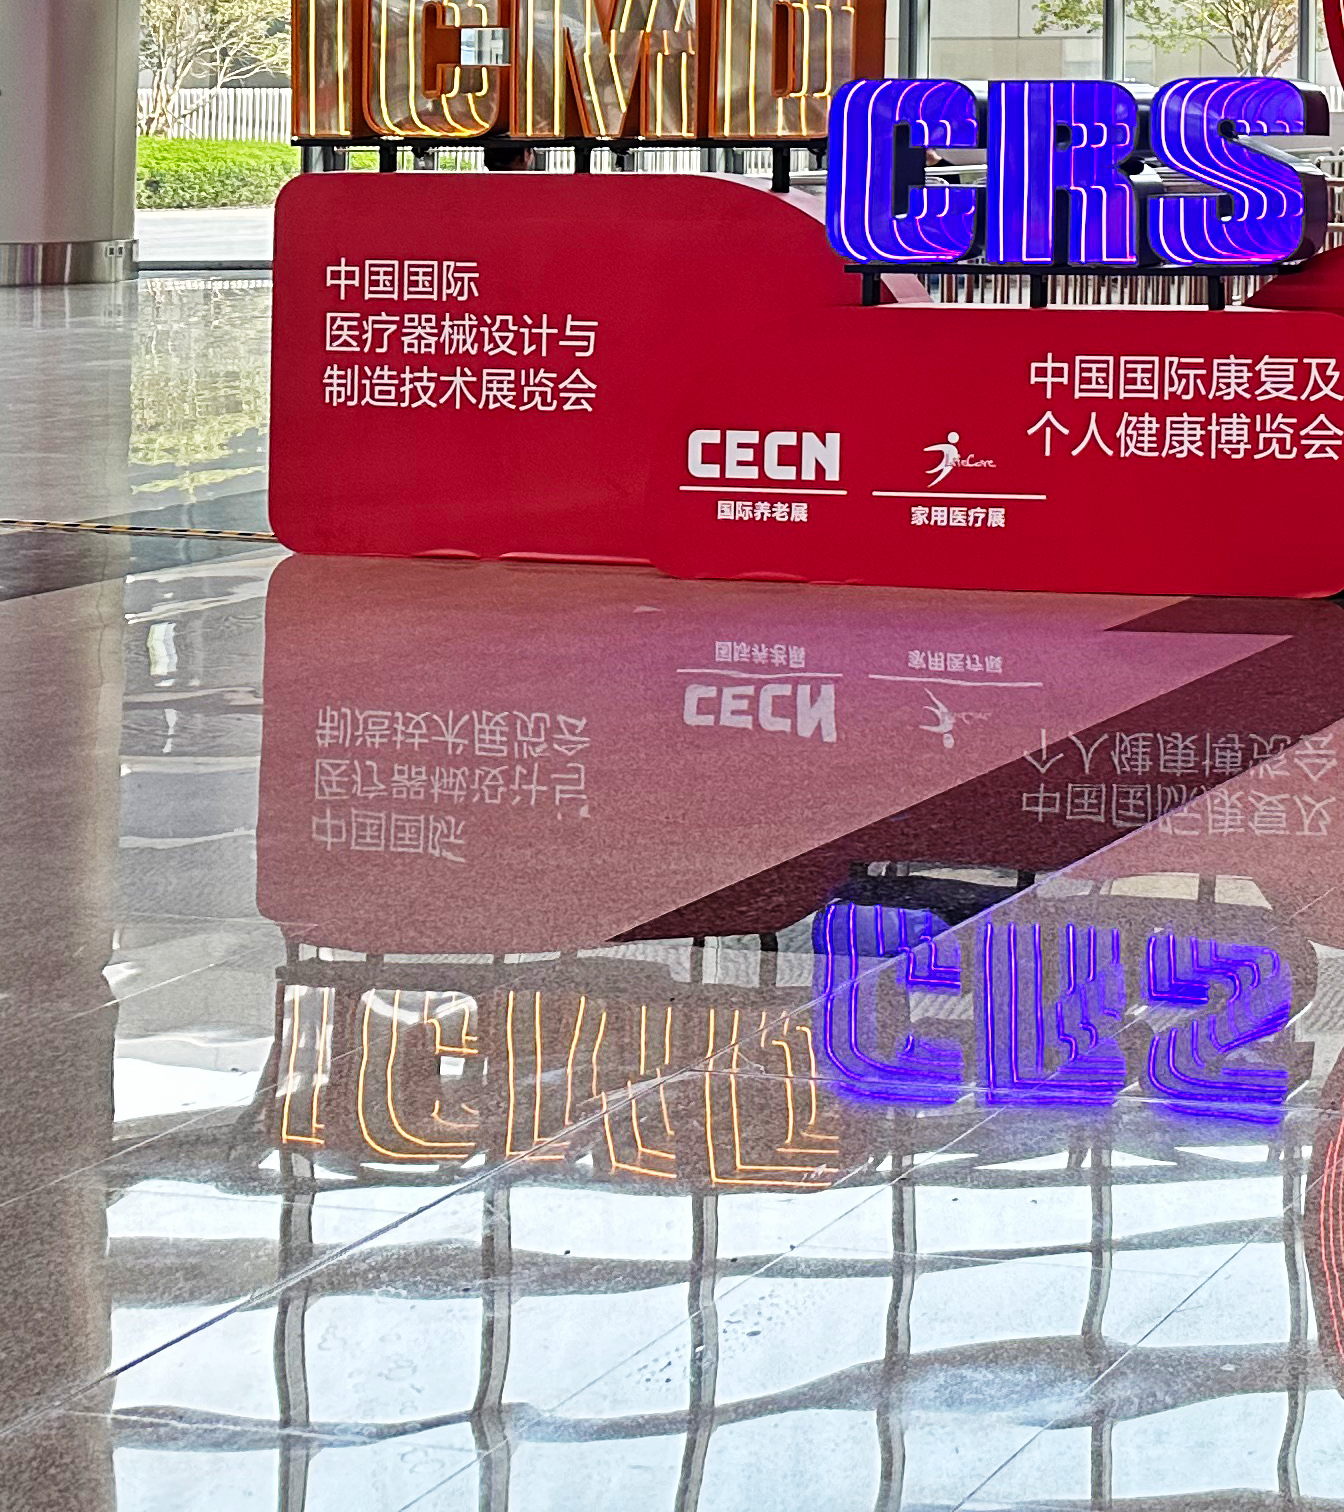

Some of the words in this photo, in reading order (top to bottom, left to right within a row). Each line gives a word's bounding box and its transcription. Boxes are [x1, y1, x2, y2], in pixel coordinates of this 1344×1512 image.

[826, 77, 1330, 265] CRS
[326, 257, 480, 301] 中国国际
[325, 312, 599, 357] 医疗器械设计与
[322, 364, 598, 412] 制造技术展览会
[1029, 352, 1344, 402] 中国国际康复及
[687, 429, 841, 482] CECN
[1026, 410, 1344, 461] 个人健康博览会
[717, 500, 808, 522] 国际养老展
[910, 505, 1006, 528] 家用医疗展
